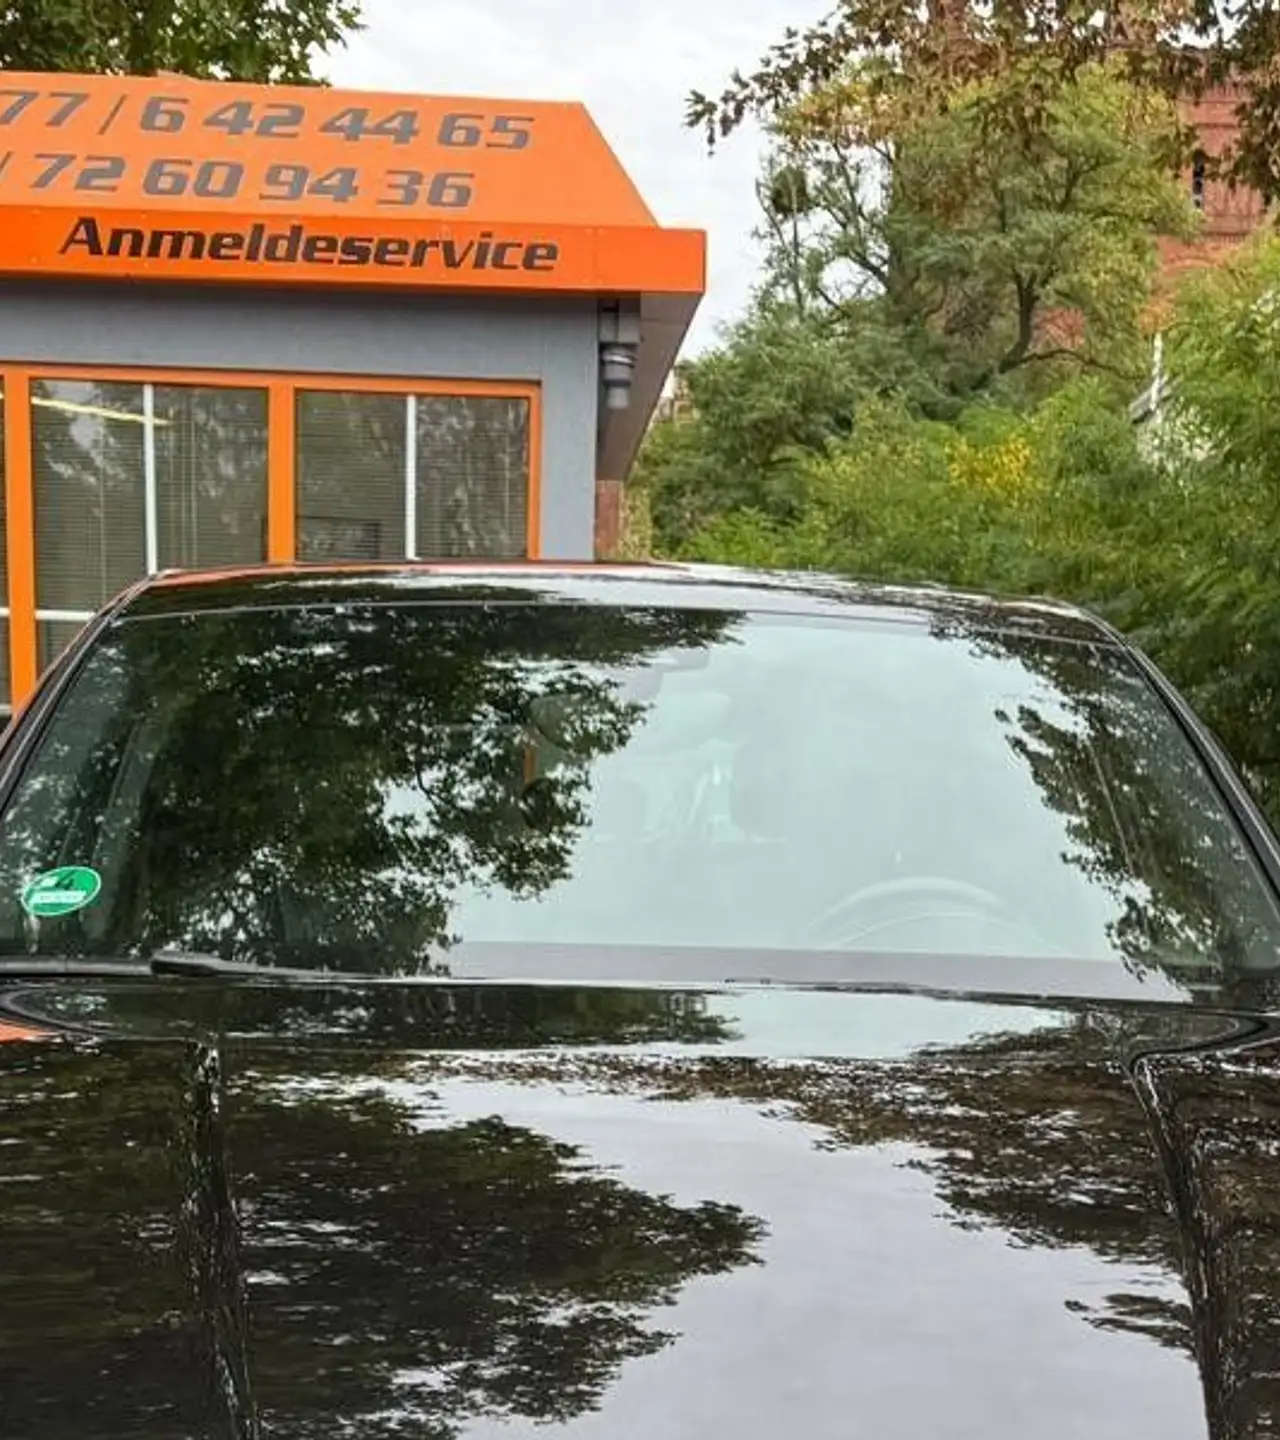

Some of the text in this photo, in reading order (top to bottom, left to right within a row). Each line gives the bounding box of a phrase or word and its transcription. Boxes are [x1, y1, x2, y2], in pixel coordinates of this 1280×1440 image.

[319, 108, 419, 145] 44
[436, 113, 535, 150] 65
[29, 153, 127, 192] 72
[143, 158, 244, 199] 60
[258, 164, 359, 202] 94
[376, 170, 476, 208] 36
[59, 216, 560, 272] Anmeldeservice
